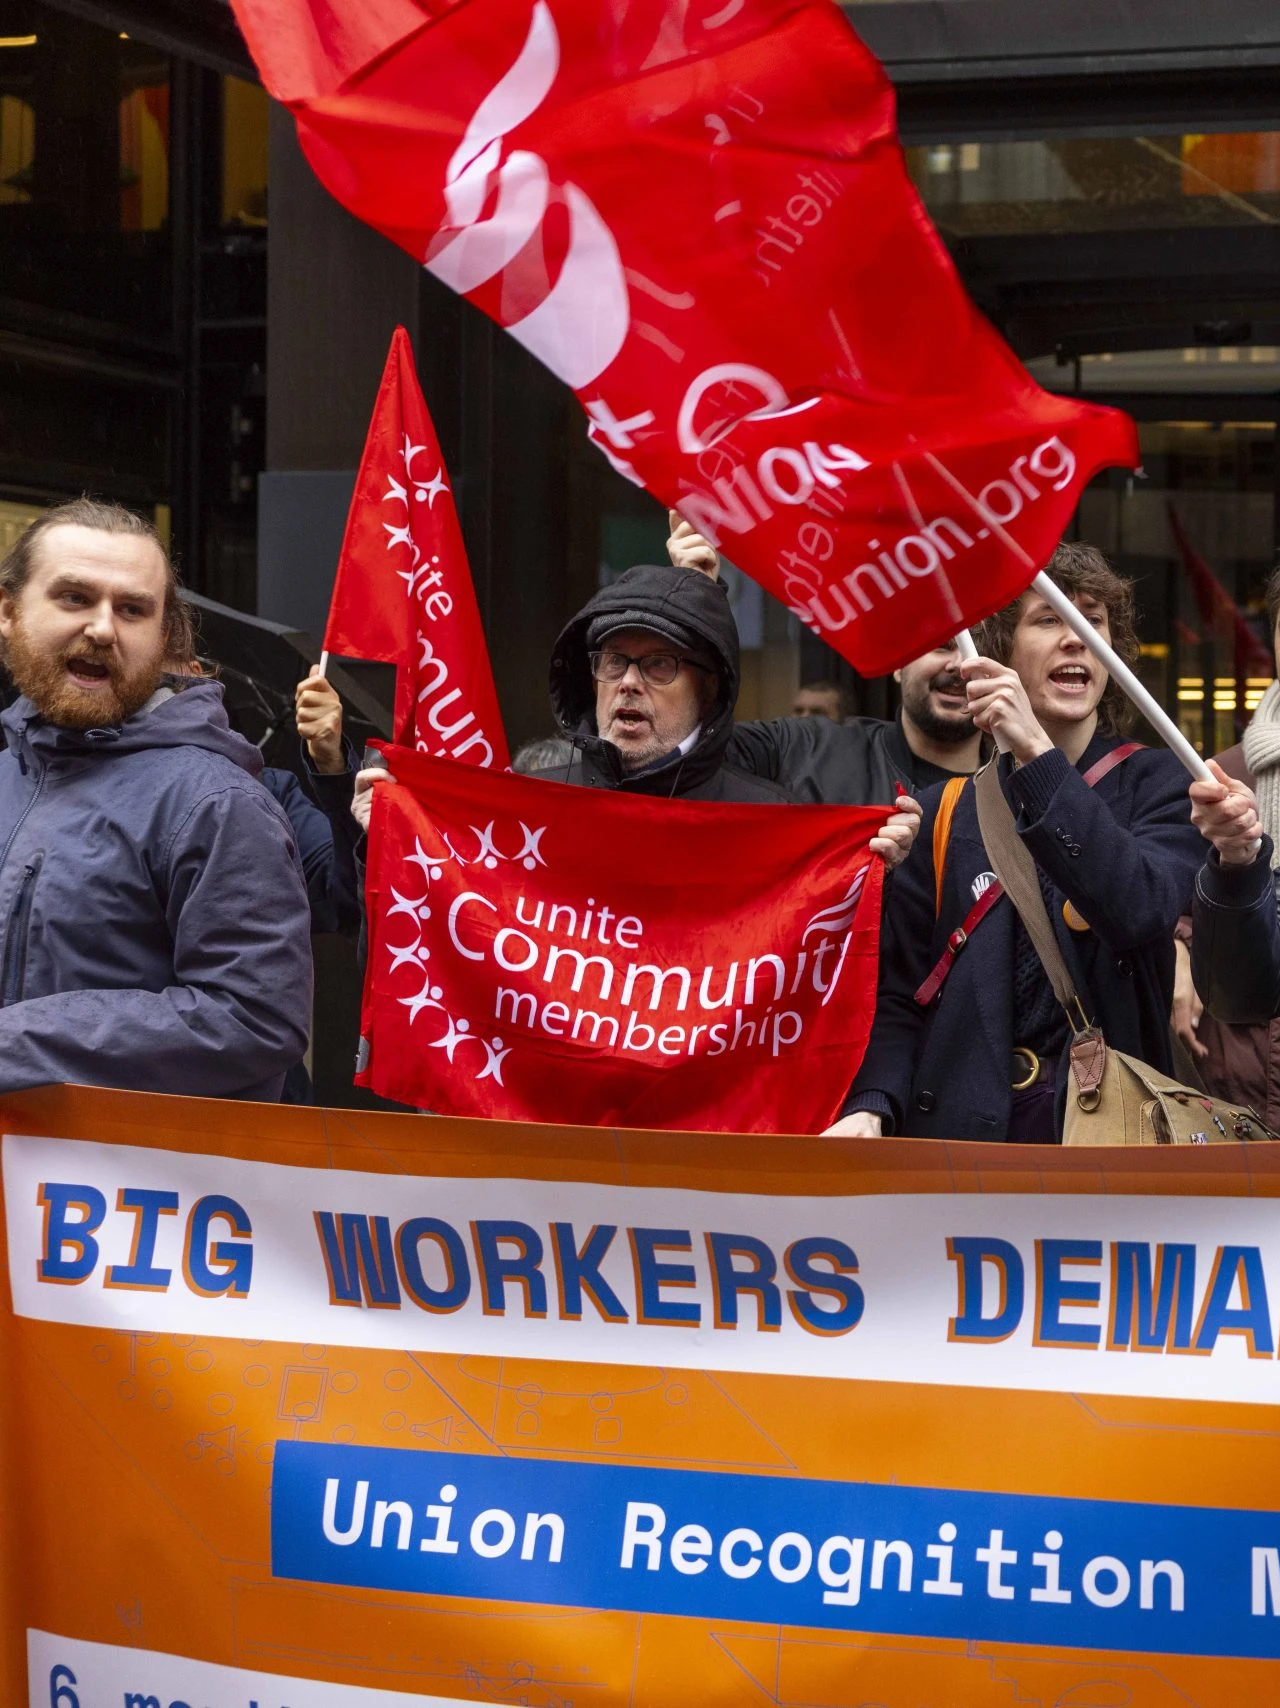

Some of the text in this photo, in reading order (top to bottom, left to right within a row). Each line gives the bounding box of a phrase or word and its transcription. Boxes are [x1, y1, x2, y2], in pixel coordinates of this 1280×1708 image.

[515, 895, 644, 950] unite
[495, 985, 803, 1057] membership
[36, 1181, 254, 1301] BIG
[314, 1208, 866, 1338] WORKERS
[321, 1477, 566, 1565] Union
[620, 1501, 1187, 1613] Recognition
